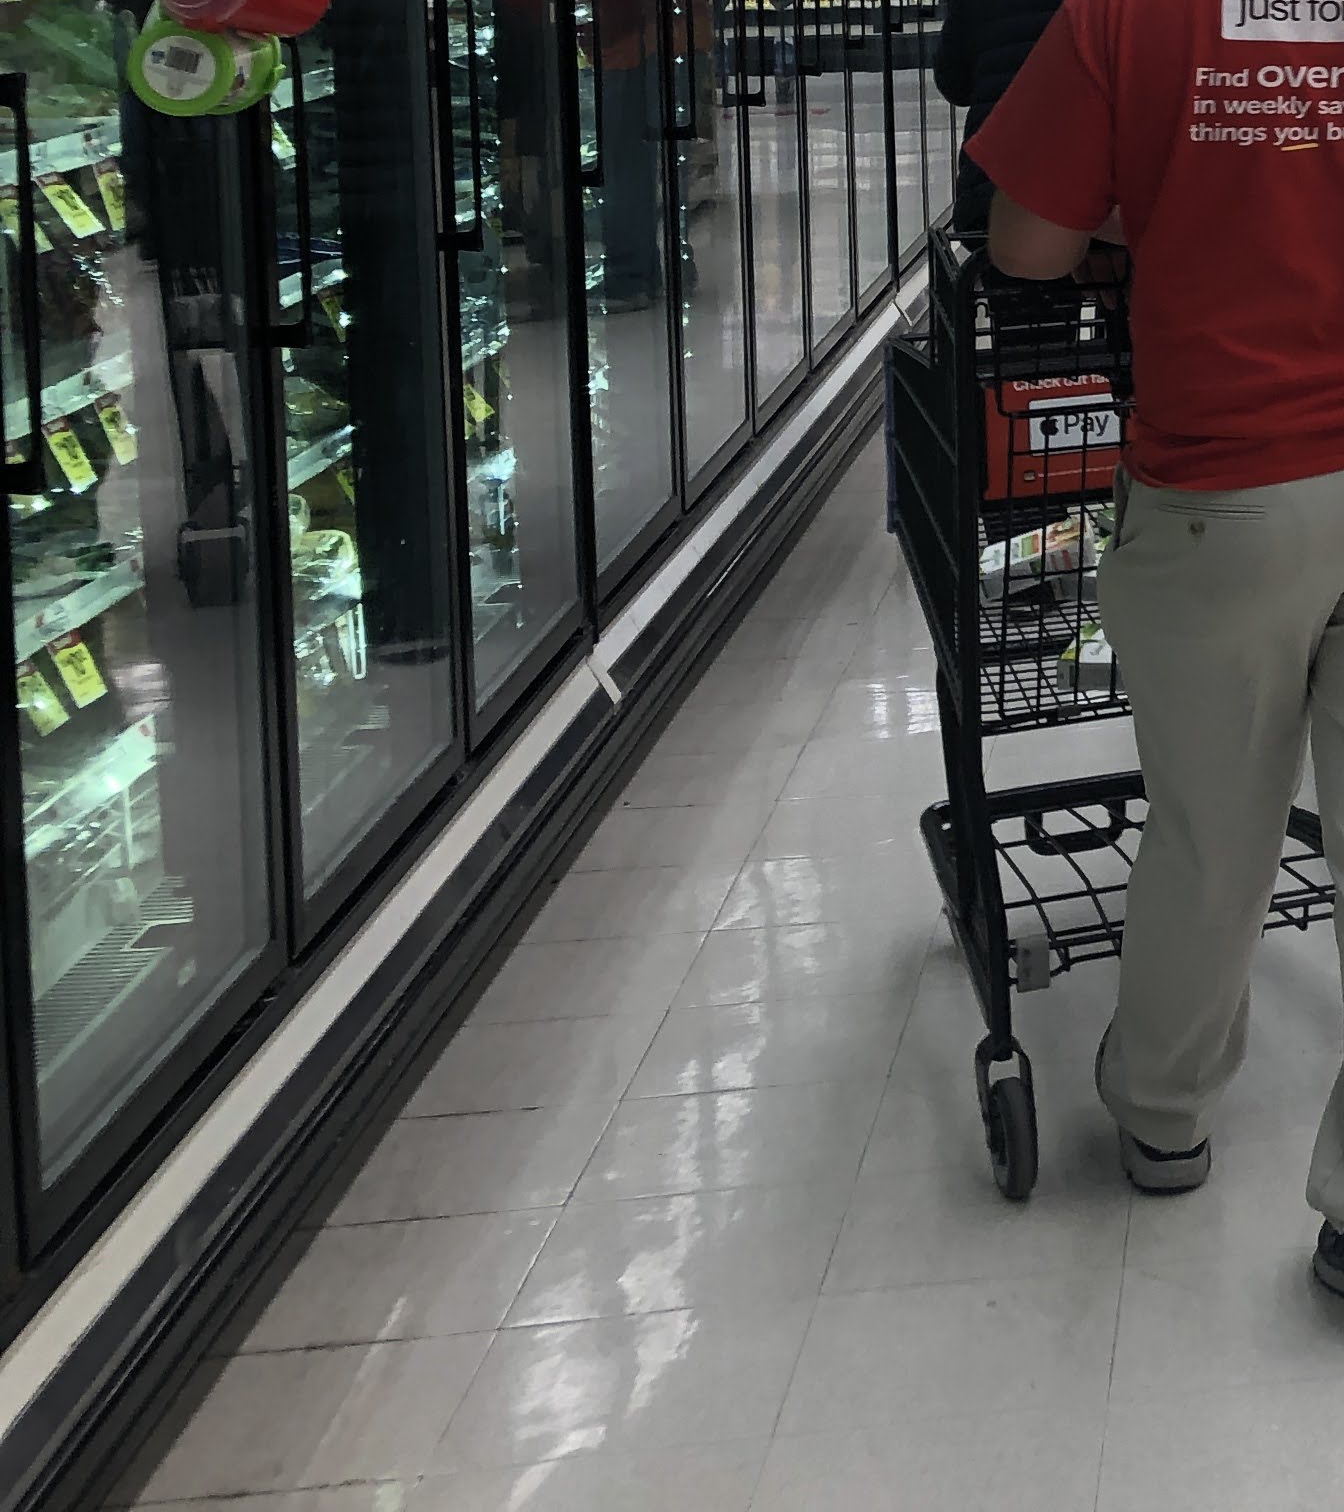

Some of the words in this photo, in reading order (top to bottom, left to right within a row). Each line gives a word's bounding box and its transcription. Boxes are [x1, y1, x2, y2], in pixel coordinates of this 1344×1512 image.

[1195, 67, 1249, 88] Find
[1193, 96, 1216, 115] in
[1224, 96, 1311, 119] weekly
[1189, 122, 1268, 146] things
[1273, 125, 1319, 146] you
[1063, 410, 1111, 437] Pay
